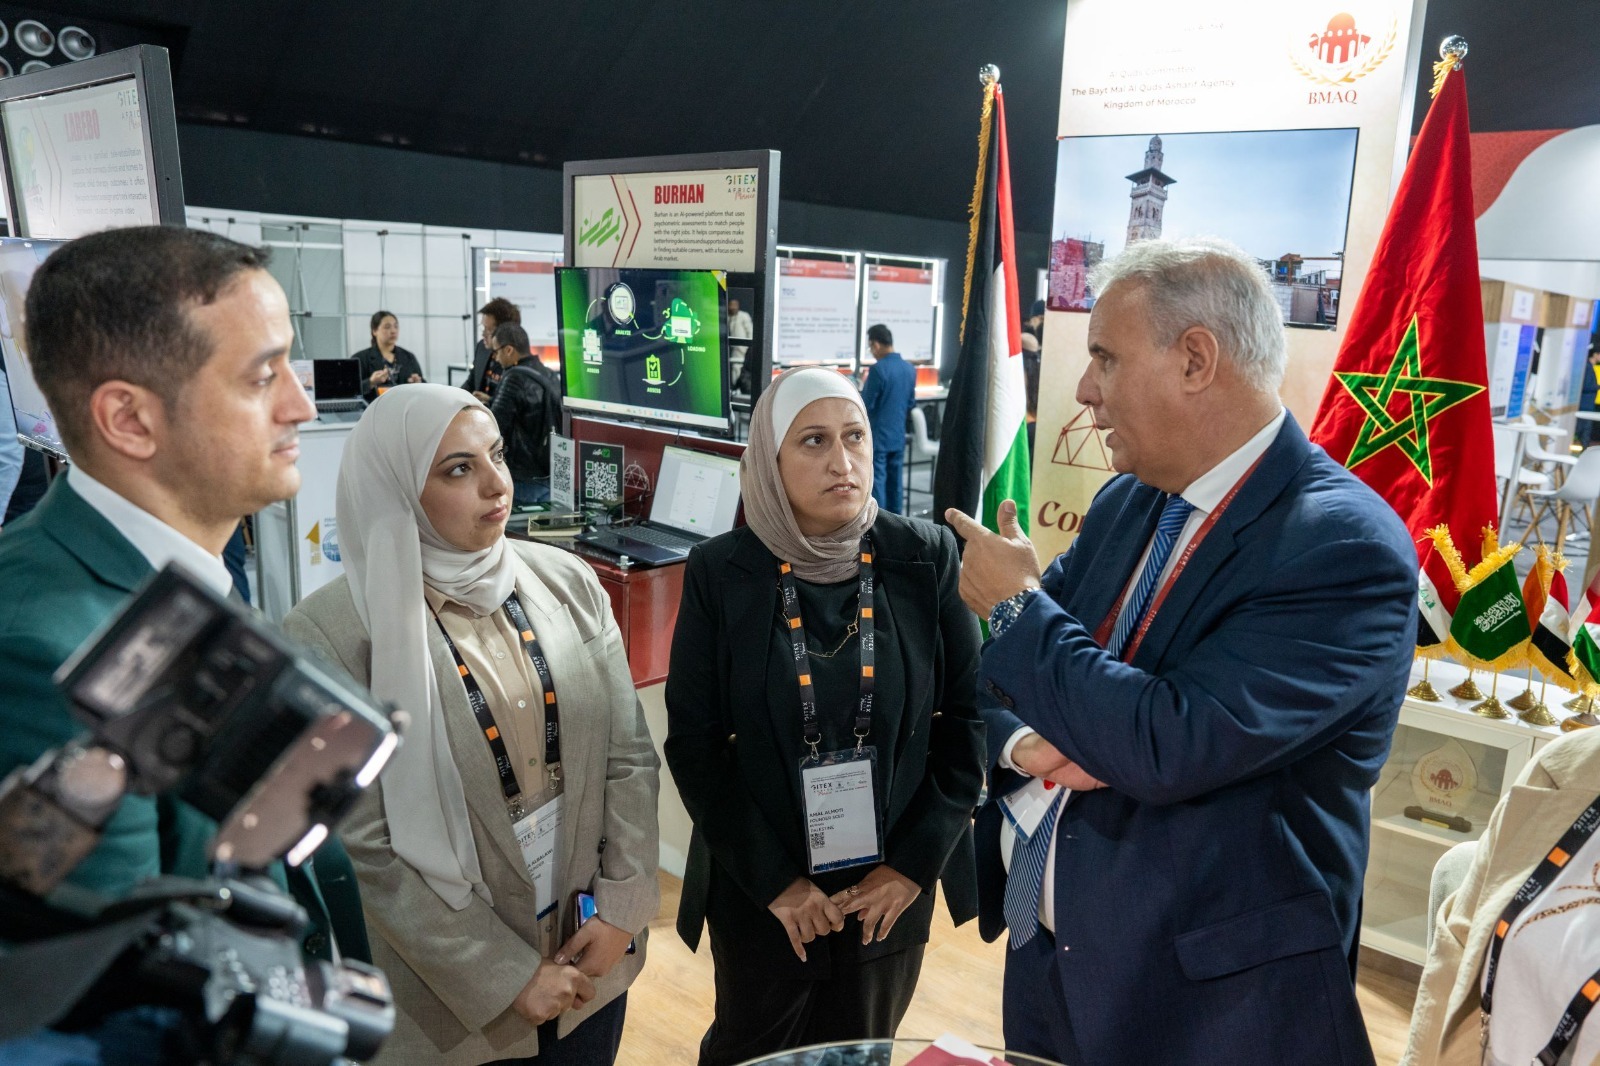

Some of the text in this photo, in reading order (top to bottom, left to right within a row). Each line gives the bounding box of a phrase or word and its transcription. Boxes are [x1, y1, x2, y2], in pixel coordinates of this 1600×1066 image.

[1089, 87, 1108, 96] Bayt
[1110, 86, 1126, 94] Mal
[1139, 84, 1162, 92] Quds
[1200, 79, 1236, 88] Agency
[117, 89, 138, 107] GITE
[1104, 98, 1196, 110] Kingdom of Morocco
[1308, 91, 1358, 105] BMAQ
[726, 174, 756, 185] GITEX
[654, 184, 704, 204] BURHAN
[532, 656, 544, 676] GITEX
[468, 692, 480, 713] GITEX
[497, 756, 506, 777] GITEX
[811, 782, 832, 791] GITEX
[1573, 806, 1598, 832] GITEX
[1514, 876, 1536, 902] GITEX
[1554, 1012, 1572, 1040] GITEX
